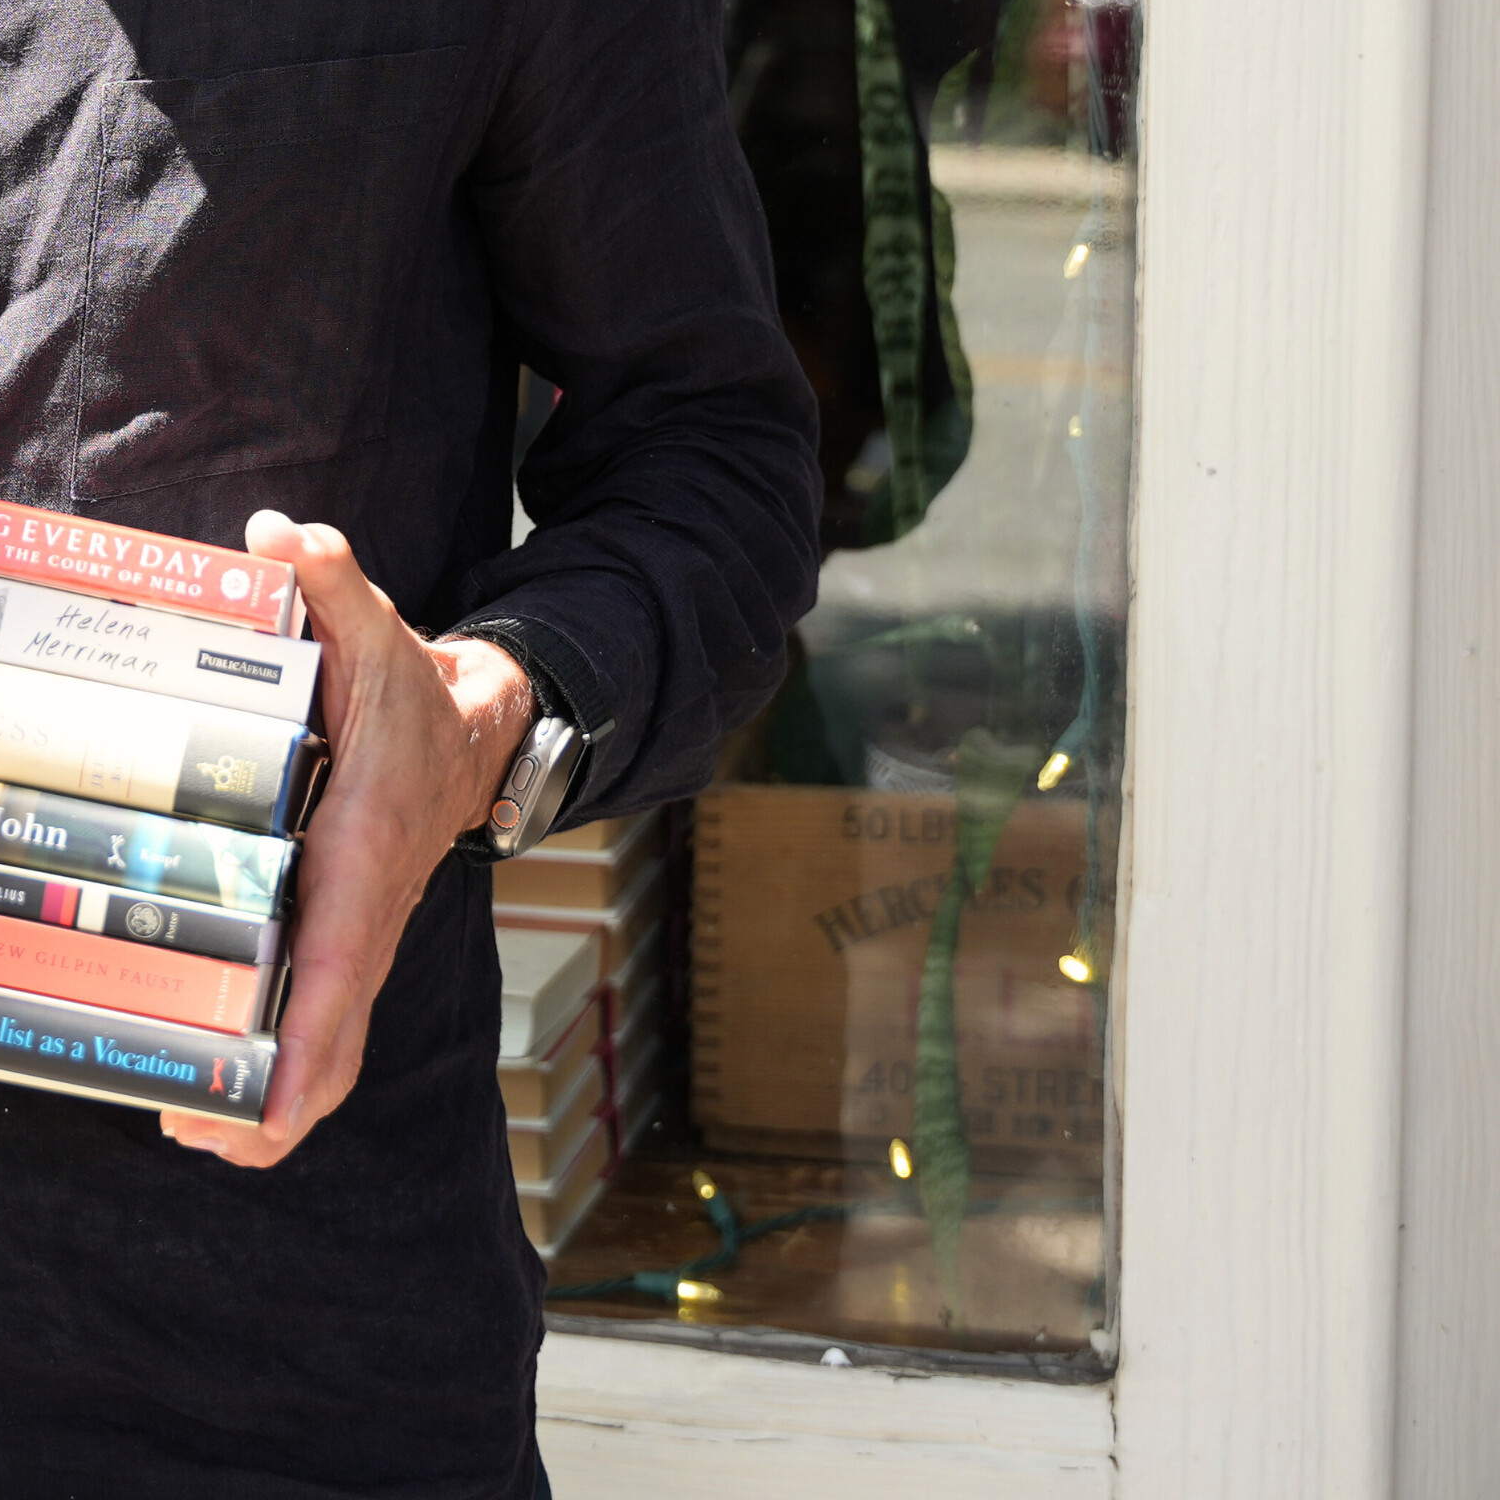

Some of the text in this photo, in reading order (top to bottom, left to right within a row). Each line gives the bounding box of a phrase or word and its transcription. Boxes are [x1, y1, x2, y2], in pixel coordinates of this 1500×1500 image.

[22, 518, 132, 562] EVERY
[140, 543, 211, 579] DAY
[4, 545, 40, 564] THE
[47, 553, 113, 579] COURT
[118, 568, 143, 585] OF
[149, 573, 203, 597] NERO
[55, 604, 151, 642] Helena
[23, 633, 159, 678] Merriman
[900, 807, 956, 843] LB
[140, 846, 182, 870] Knopf
[165, 912, 179, 942] Potter
[35, 950, 109, 978] GILPIN
[119, 967, 186, 993] FAUST
[212, 967, 231, 1022] PICADOR
[39, 1035, 66, 1056] as
[71, 1042, 86, 1061] a
[93, 1035, 197, 1083] Vocation
[228, 1056, 252, 1100] Knopf
